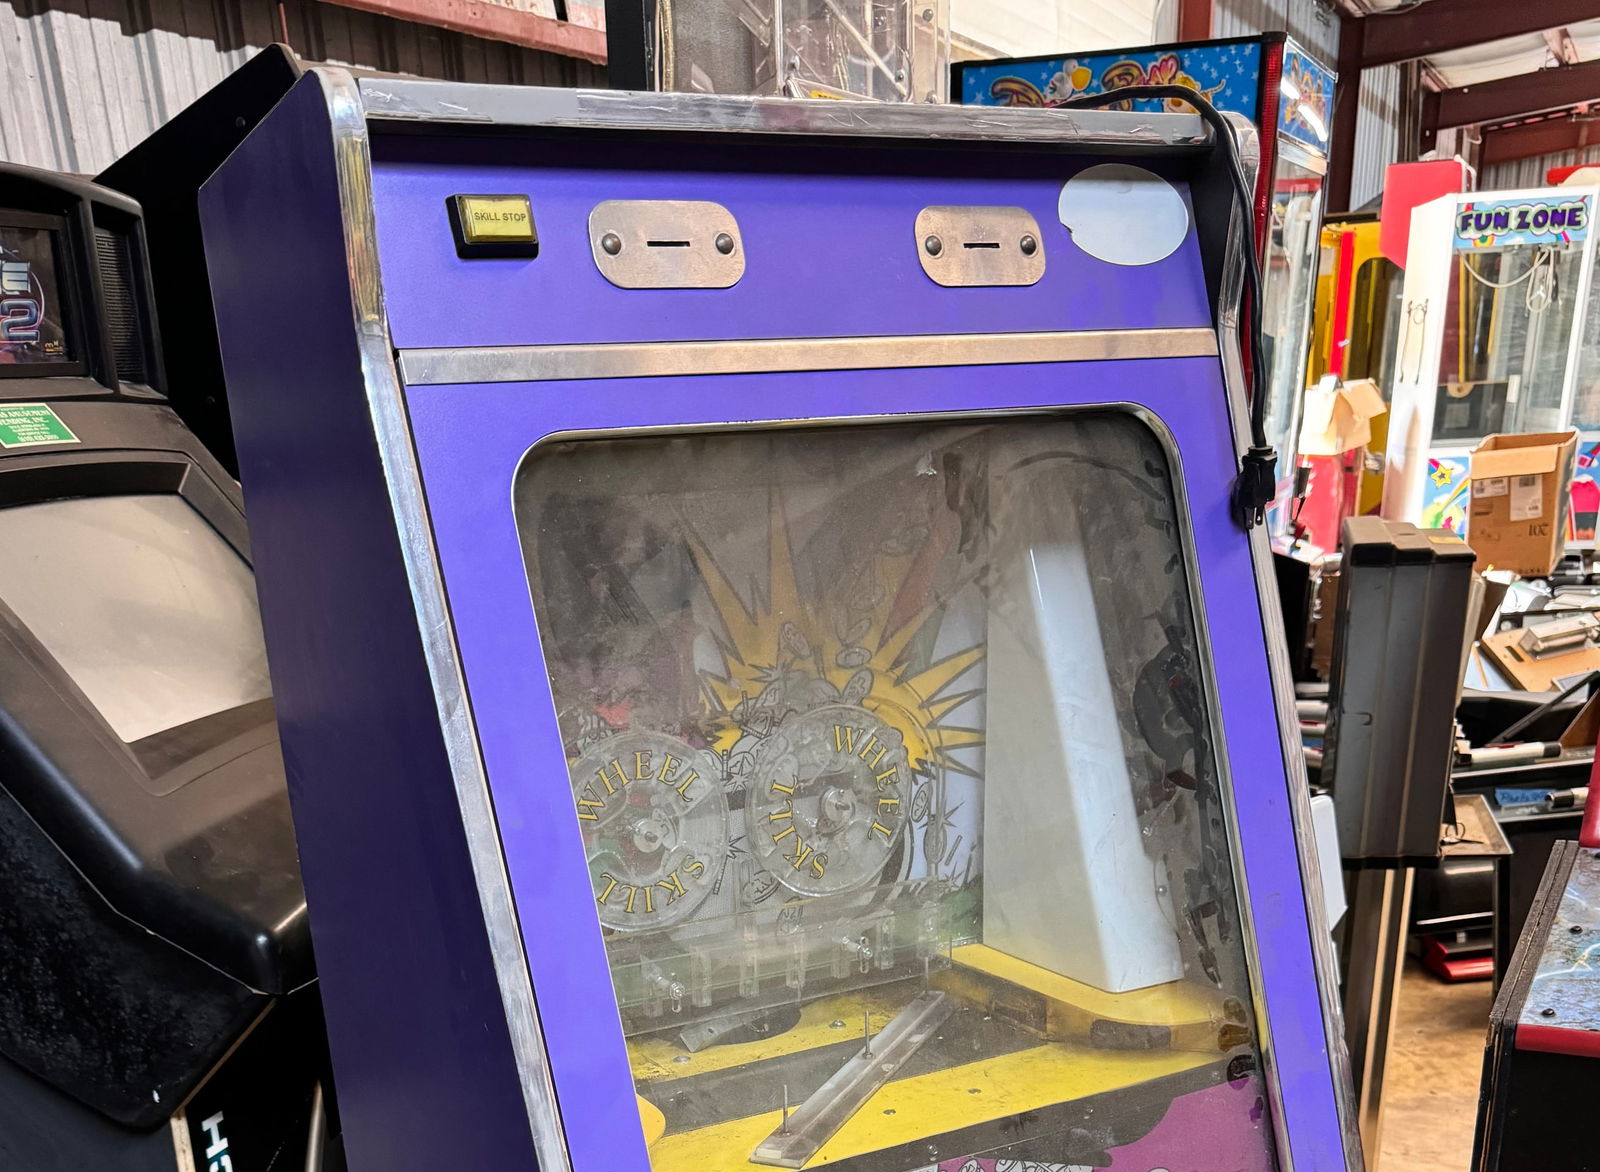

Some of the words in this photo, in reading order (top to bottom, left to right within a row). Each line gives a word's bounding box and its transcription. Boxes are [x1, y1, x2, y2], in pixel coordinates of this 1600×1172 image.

[473, 211, 500, 221] SKILL
[502, 212, 526, 222] STOP
[1461, 211, 1510, 232] FUN
[1515, 206, 1584, 230] ZONE
[577, 749, 700, 822] WHEEL
[833, 724, 901, 841] WHEEL
[768, 774, 829, 880] SKILL
[596, 854, 705, 914] SKILL
